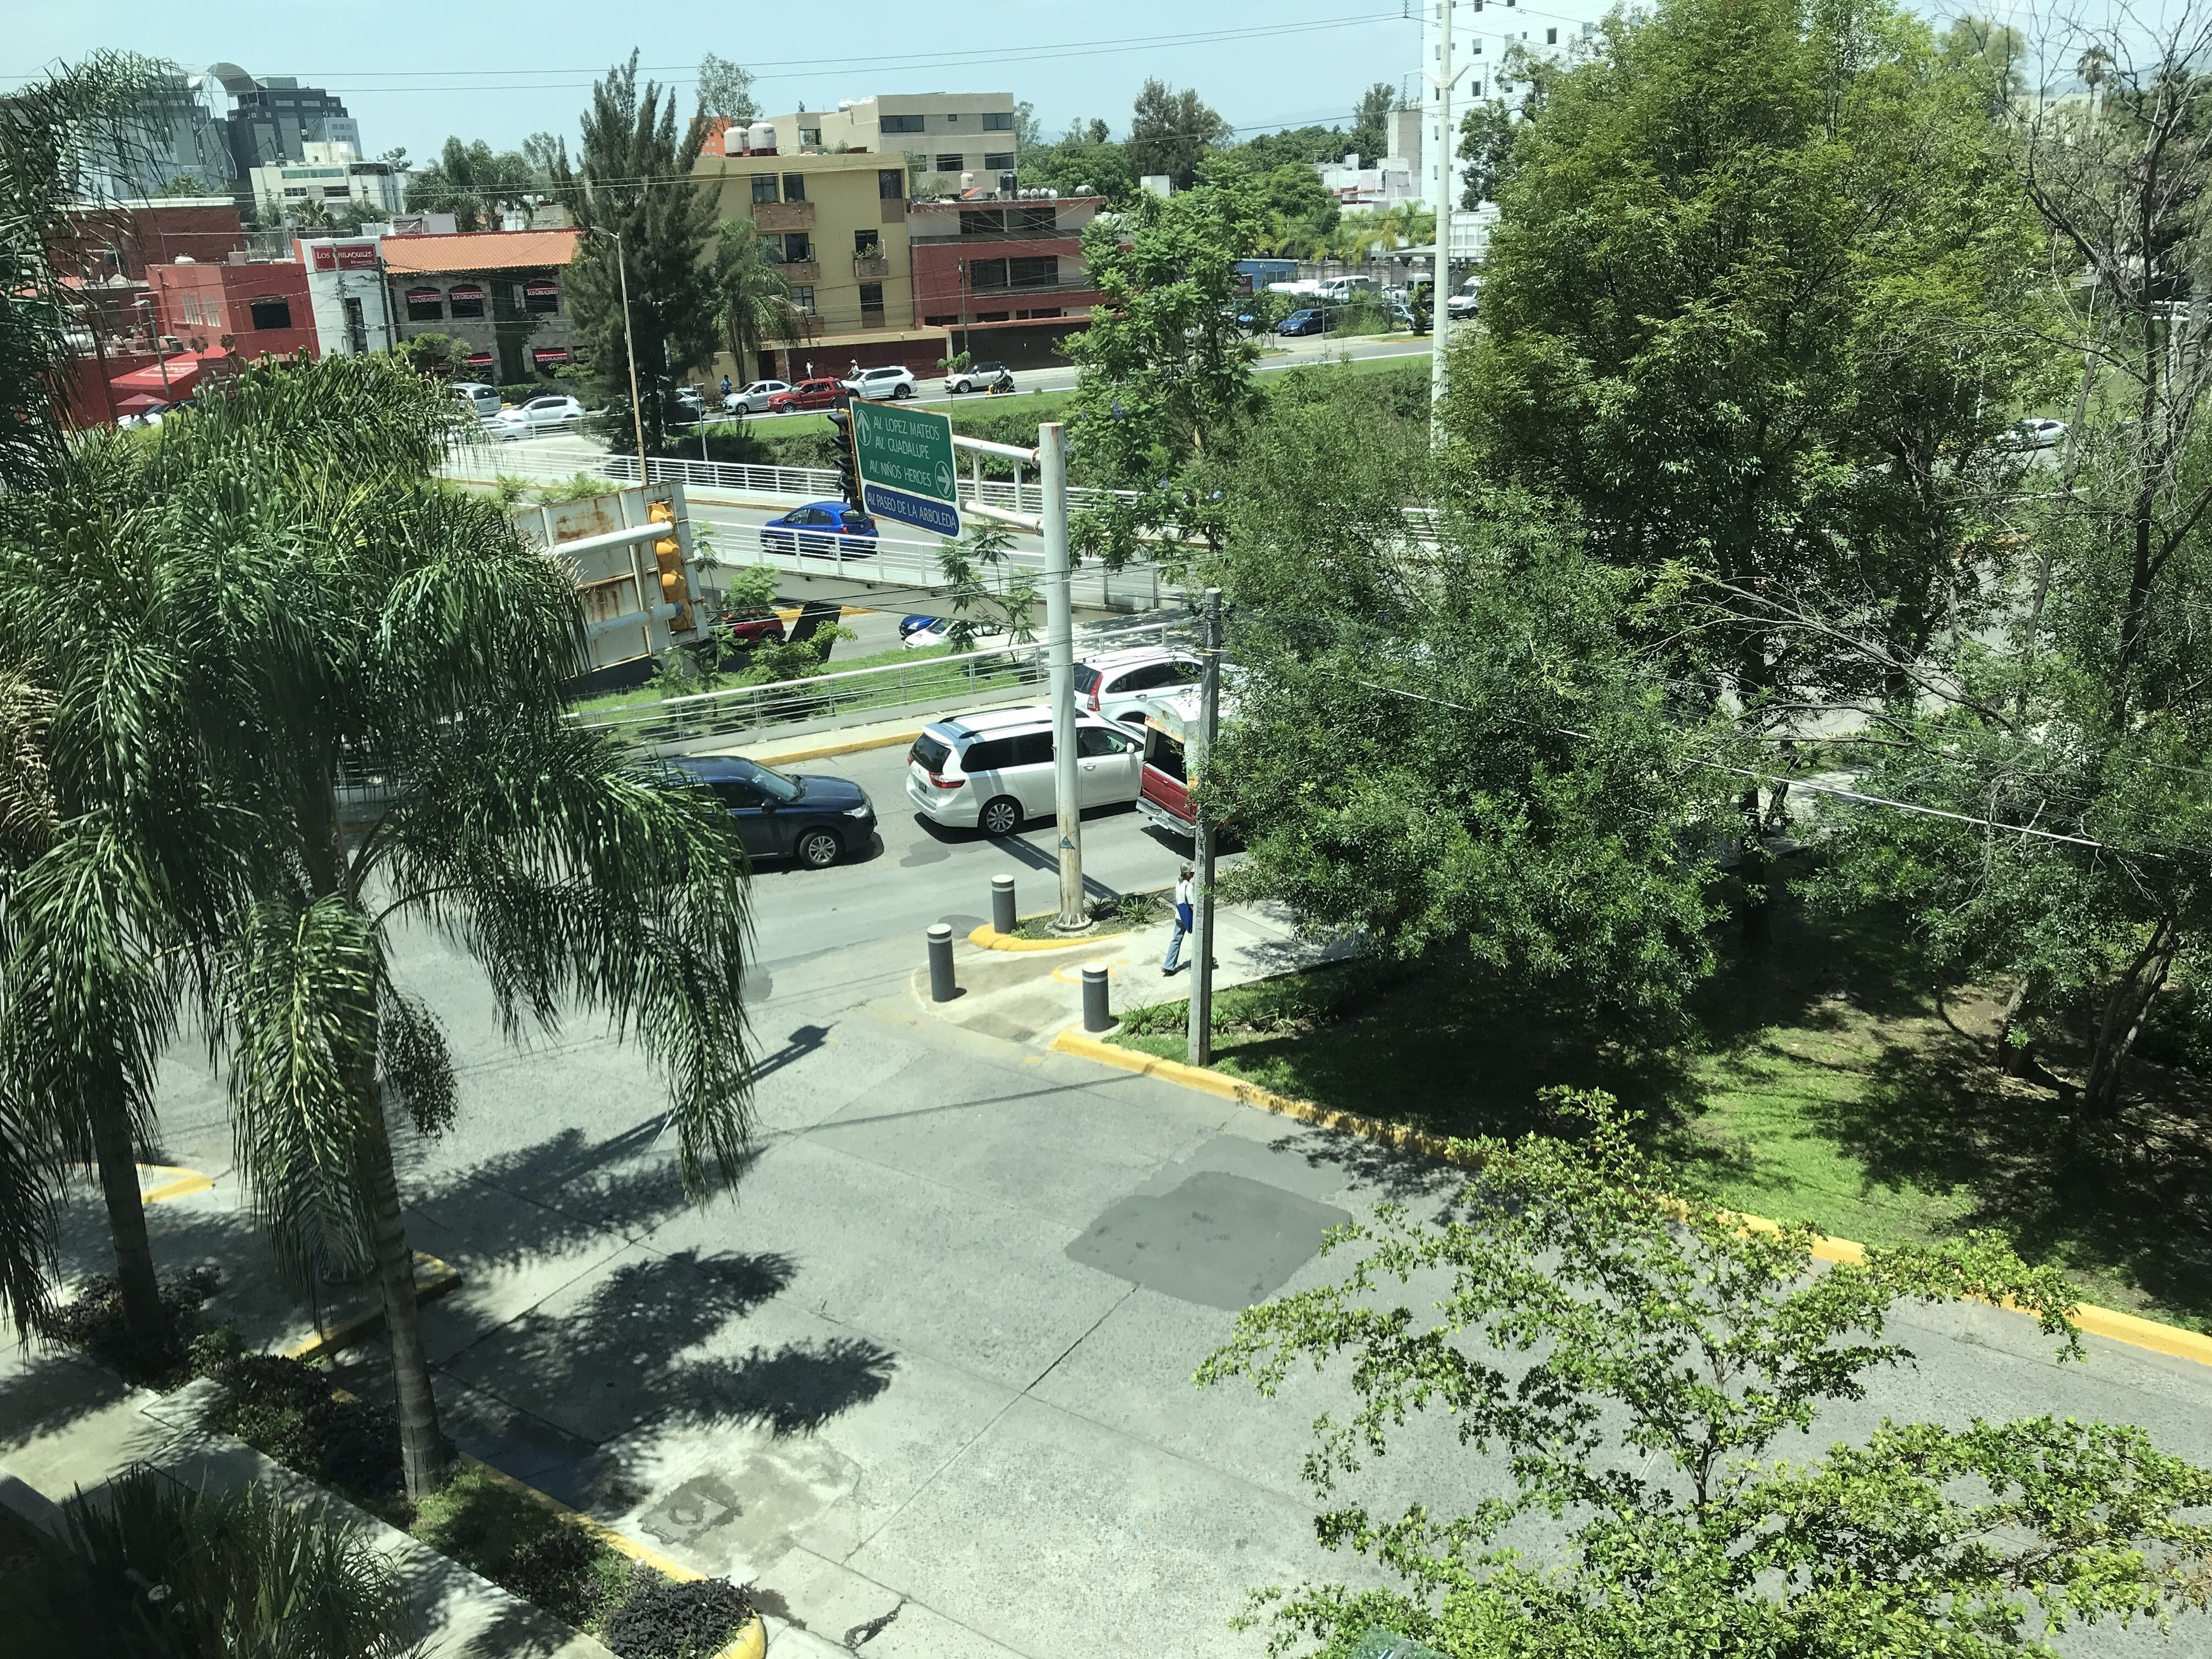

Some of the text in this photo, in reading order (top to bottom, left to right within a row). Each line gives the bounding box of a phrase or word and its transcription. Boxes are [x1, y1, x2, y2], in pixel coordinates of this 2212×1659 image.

[873, 415, 940, 441] AV. LOPEZ MATEOS
[876, 436, 930, 460] AV. GUADALUPE
[870, 460, 931, 487] AV. NIÑOS HEROES
[868, 492, 957, 529] AV. PASEO DE LA ARBOLEDA
